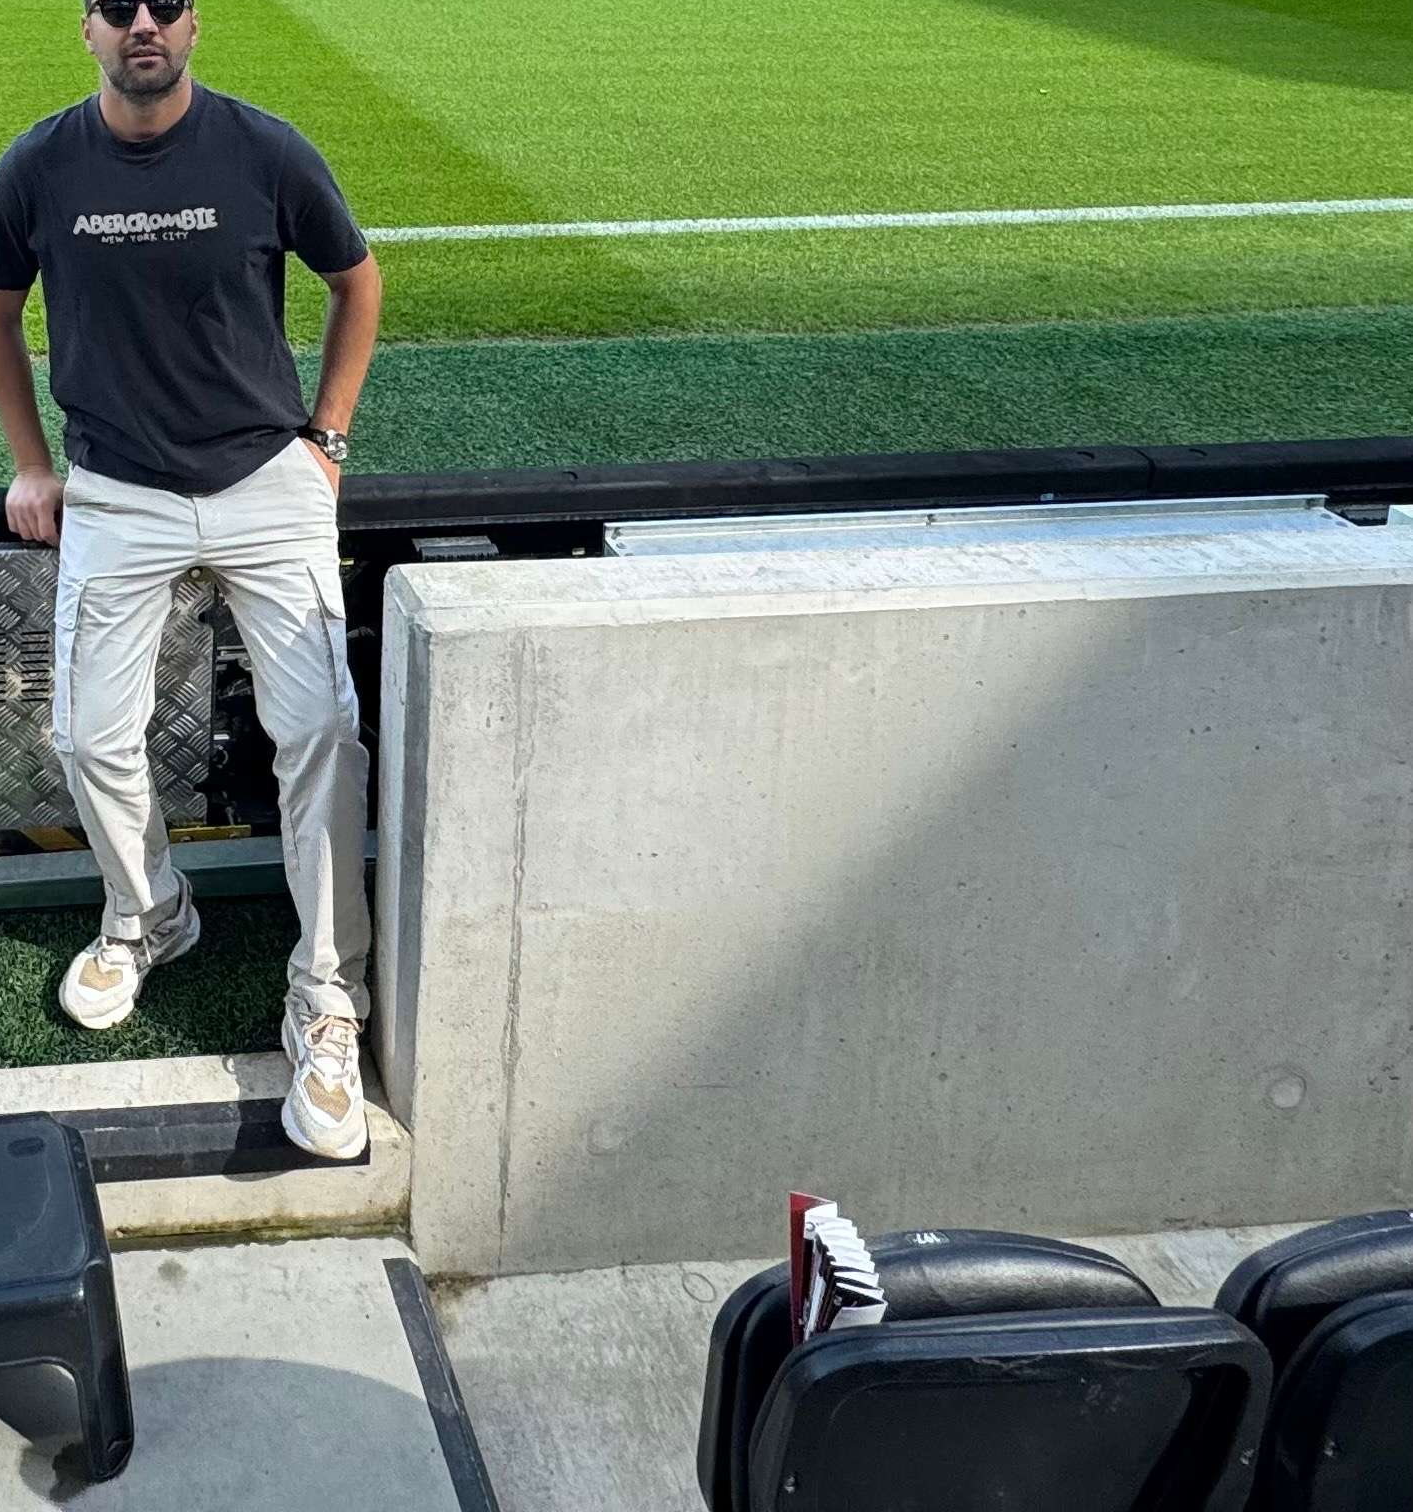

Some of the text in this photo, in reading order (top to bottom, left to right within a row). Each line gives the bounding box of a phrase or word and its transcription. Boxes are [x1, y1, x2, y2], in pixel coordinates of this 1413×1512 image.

[73, 207, 218, 235] ABERCROMBIE
[101, 231, 189, 245] NEW YORK CITY
